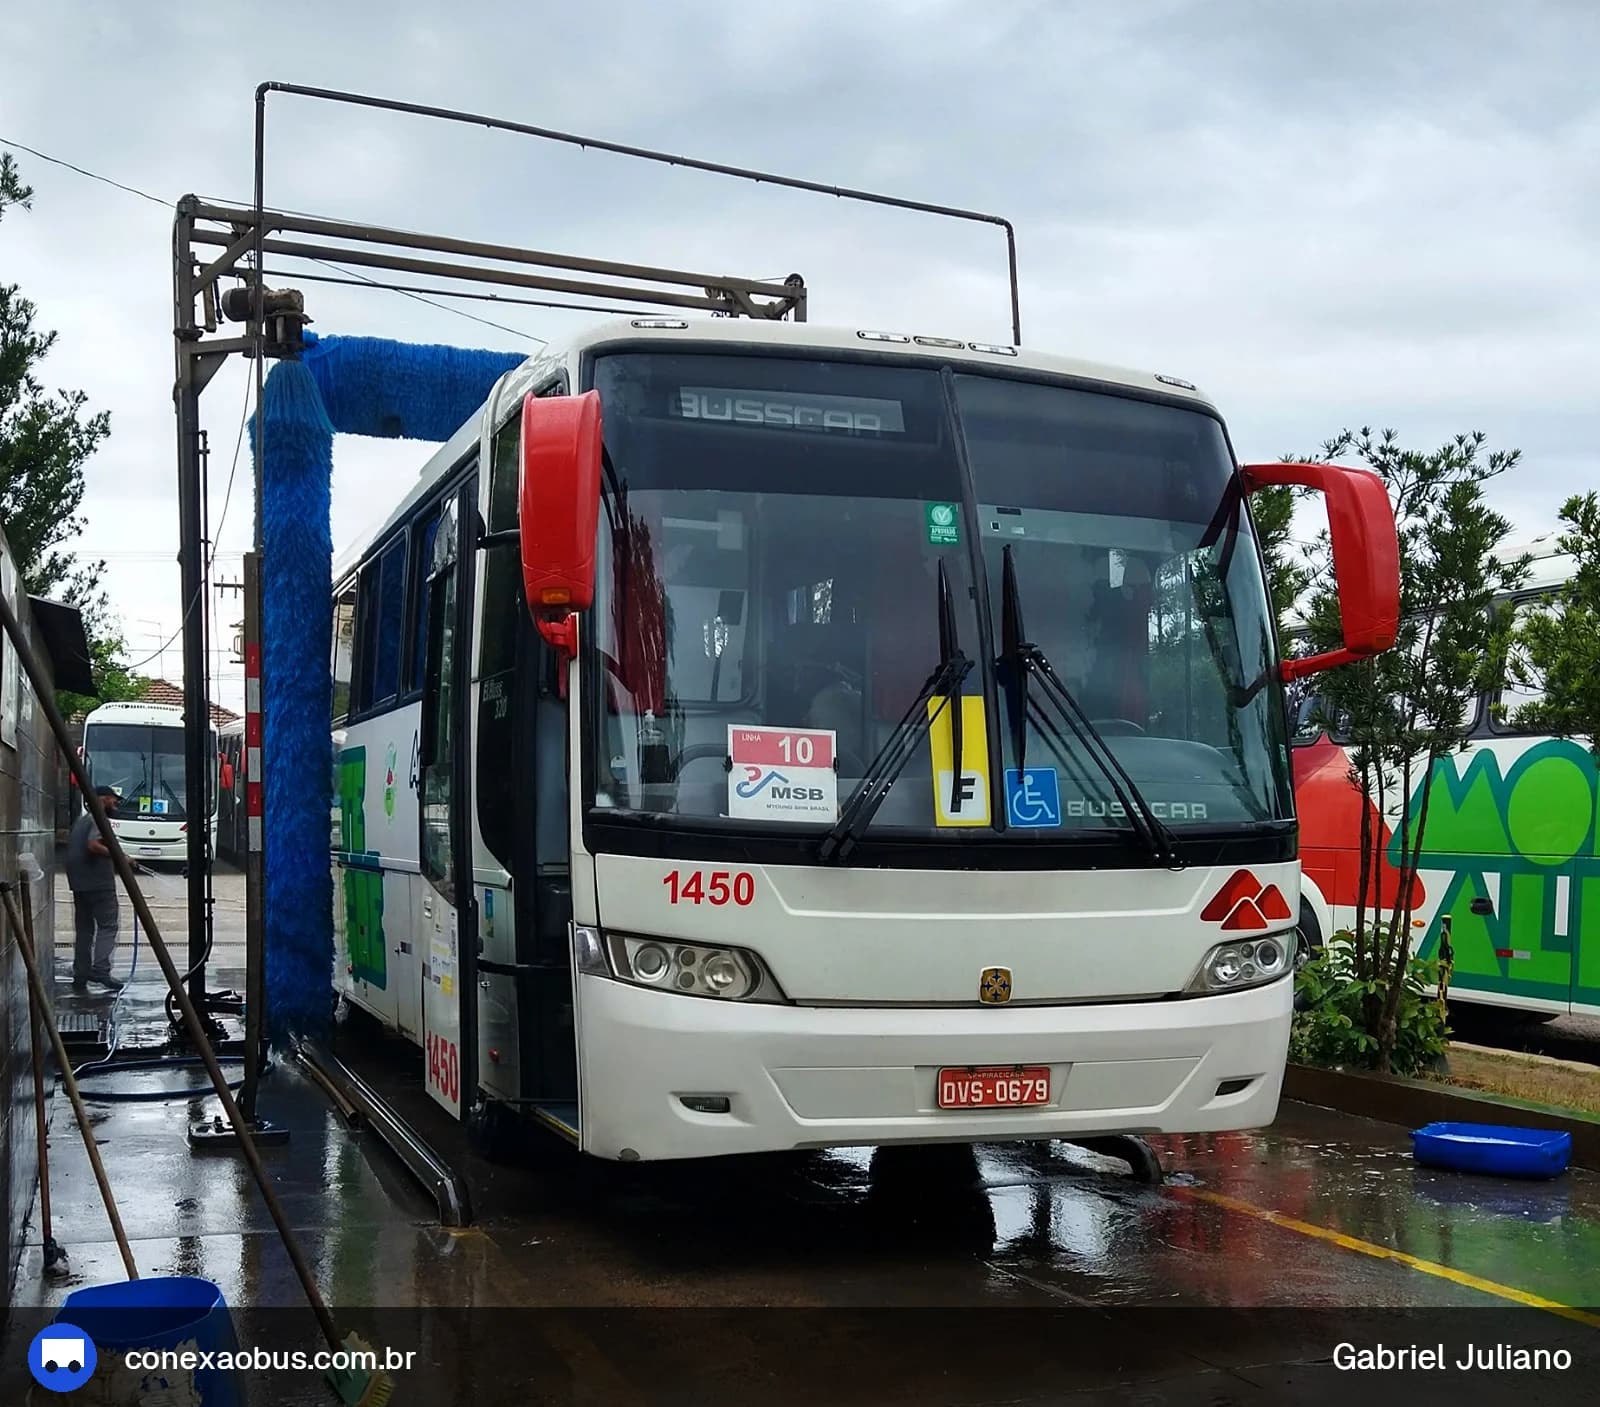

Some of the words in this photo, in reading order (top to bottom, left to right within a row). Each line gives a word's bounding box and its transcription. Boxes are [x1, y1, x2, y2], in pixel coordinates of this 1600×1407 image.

[668, 392, 882, 437] BUSSCAR
[741, 733, 762, 742] LINHA
[778, 735, 814, 764] 10
[771, 786, 824, 801] MSB
[950, 777, 976, 813] F
[662, 870, 756, 907] 1450
[426, 1030, 459, 1104] 1450
[942, 1079, 1048, 1104] DVS-0679
